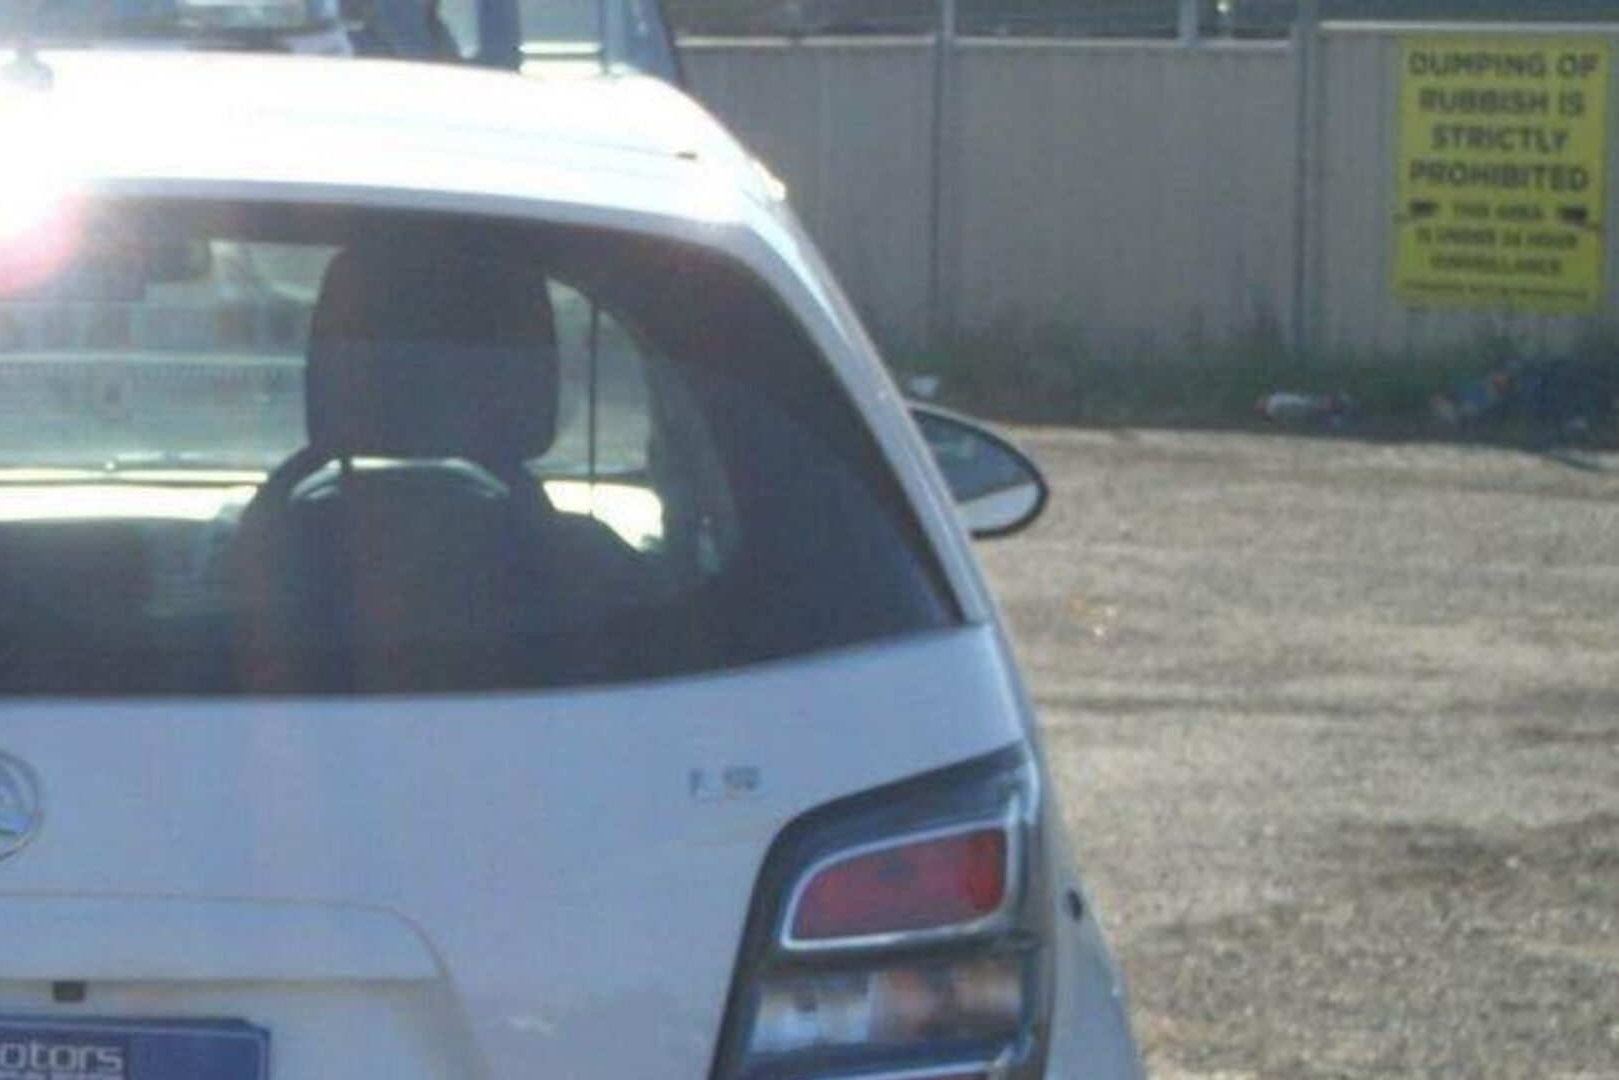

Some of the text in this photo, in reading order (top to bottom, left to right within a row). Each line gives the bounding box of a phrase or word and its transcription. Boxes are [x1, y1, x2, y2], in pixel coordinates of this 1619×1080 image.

[1407, 51, 1599, 79] DUMPING OF
[1419, 87, 1585, 118] RUBBISH IS
[1431, 124, 1569, 153] STRICTLY
[1409, 158, 1589, 192] PROHIBITED
